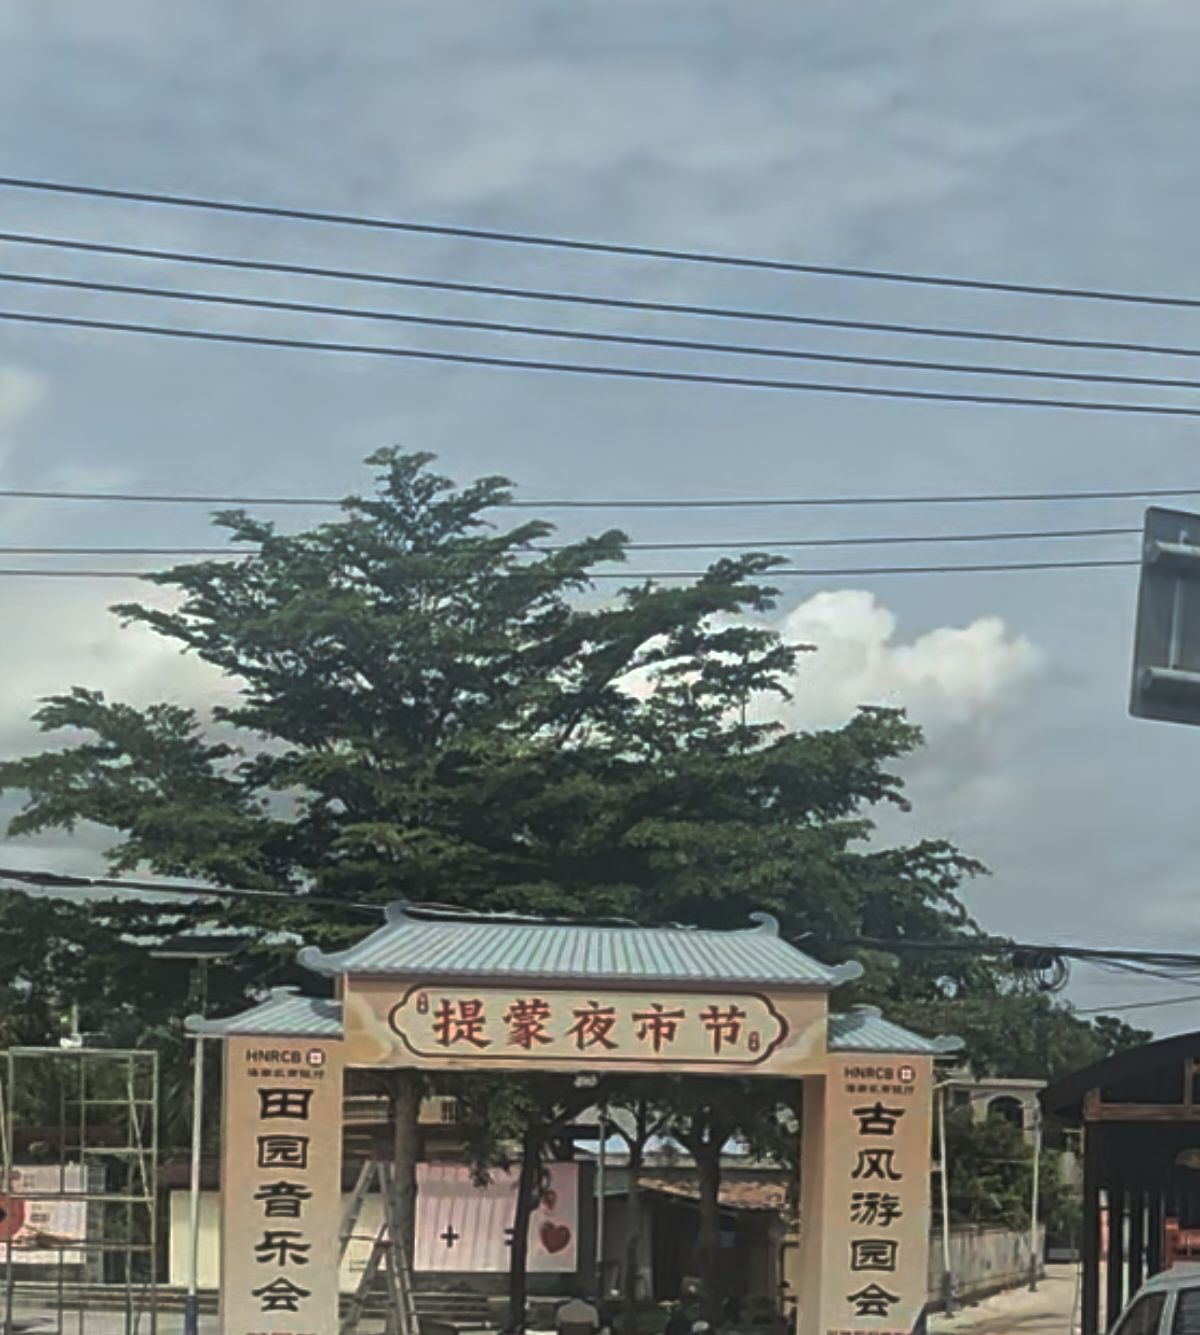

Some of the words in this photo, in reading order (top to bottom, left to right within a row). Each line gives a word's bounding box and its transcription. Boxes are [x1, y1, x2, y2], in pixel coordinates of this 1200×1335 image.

[246, 1049, 302, 1063] HNRCB
[432, 998, 747, 1055] 提蒙夜市节
[252, 1088, 314, 1313] 田园音乐会
[846, 1101, 905, 1317] 古风游园会
